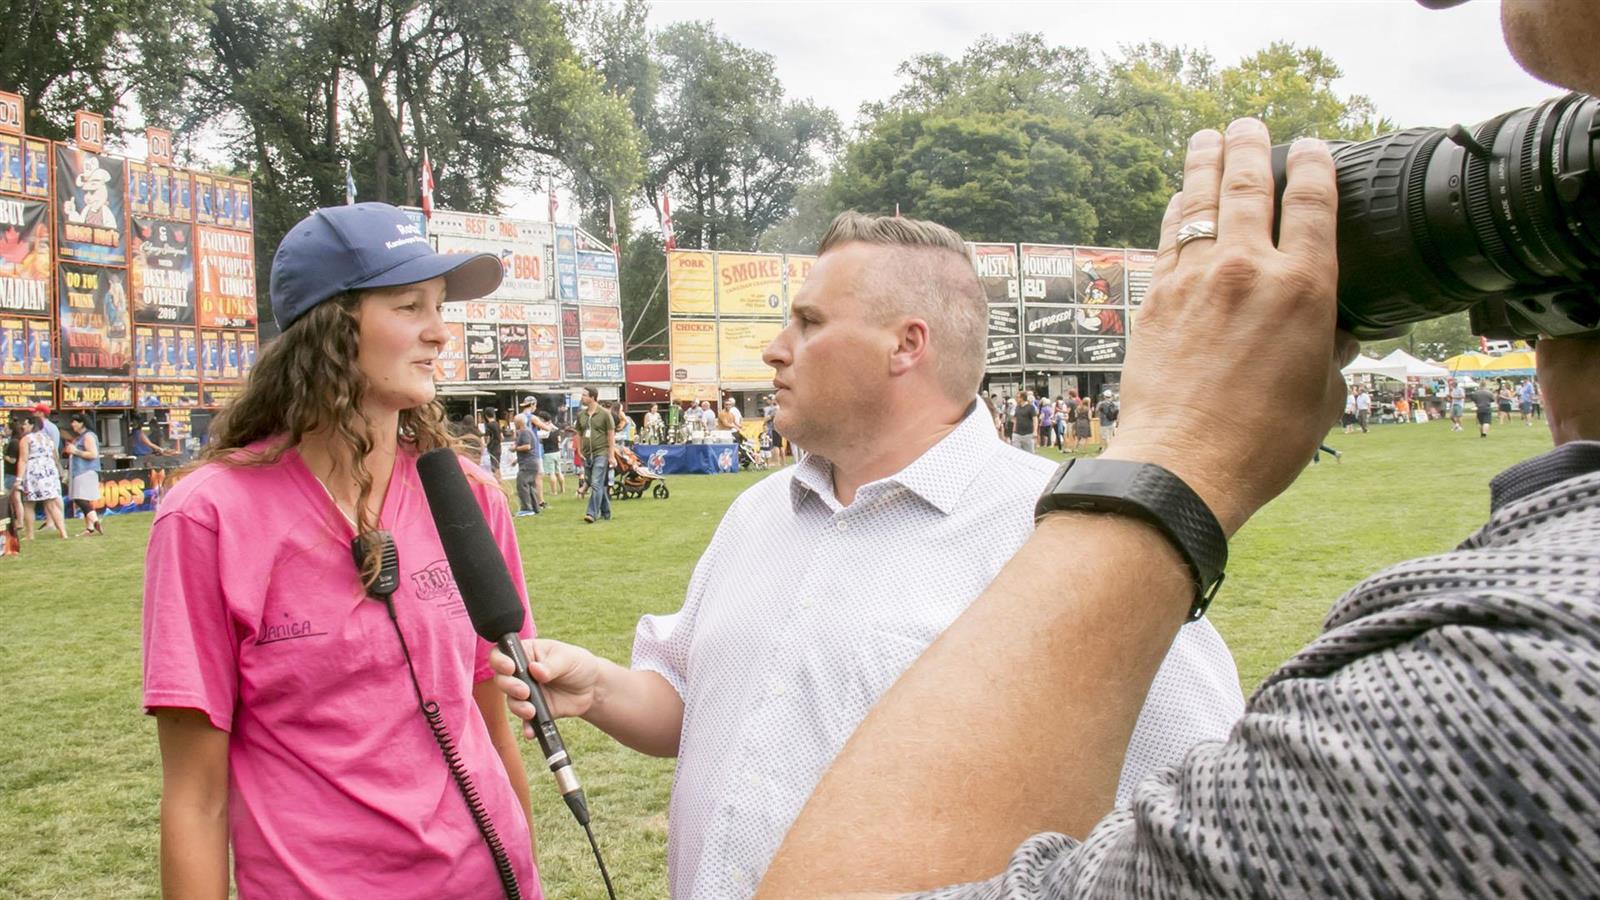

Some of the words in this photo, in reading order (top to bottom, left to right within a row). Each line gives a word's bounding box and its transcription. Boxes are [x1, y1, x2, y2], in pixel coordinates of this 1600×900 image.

[80, 120, 99, 144] 01
[151, 136, 169, 158] 01
[1552, 143, 1560, 175] CANON
[1500, 186, 1506, 194] IN
[1502, 200, 1512, 220] MADE
[514, 254, 541, 281] BBQ
[680, 259, 705, 268] PORK
[722, 259, 780, 287] SMOKE
[977, 253, 1009, 277] MISTY
[143, 286, 188, 307] OVERALL
[675, 323, 715, 332] CHICKEN
